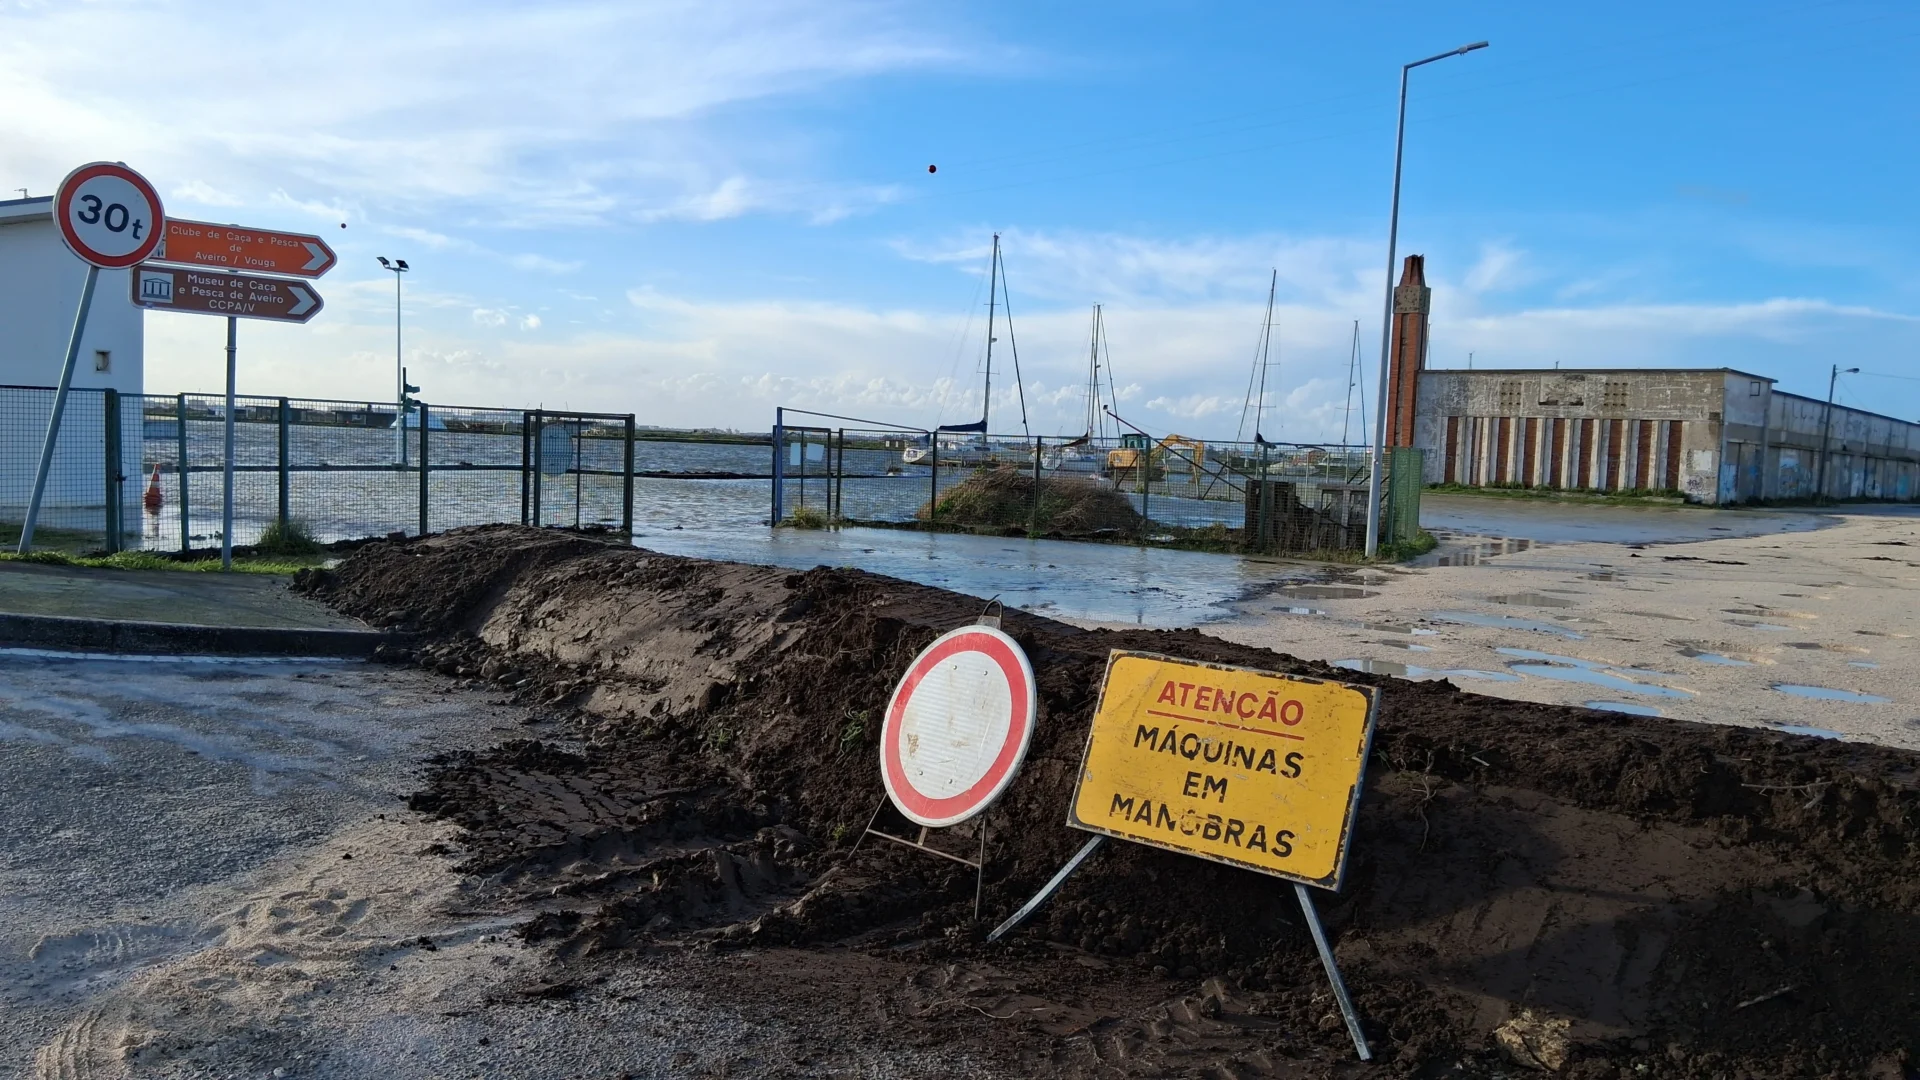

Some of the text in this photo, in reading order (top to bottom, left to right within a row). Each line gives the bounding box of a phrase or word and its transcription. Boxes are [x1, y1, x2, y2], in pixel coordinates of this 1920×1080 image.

[171, 225, 201, 237] Clube
[207, 230, 220, 239] de
[226, 231, 252, 244] Caça
[270, 236, 299, 248] Pesca
[229, 243, 242, 253] de
[195, 251, 227, 262] Aveiro
[244, 255, 276, 268] Vouga
[187, 274, 225, 286] Museu
[229, 278, 244, 288] de
[178, 286, 284, 304] e Pesca de Aveiro
[208, 299, 256, 313] CCPA/V
[1133, 723, 1305, 779] MÁQUINAS
[1182, 770, 1229, 804] EM
[1108, 792, 1296, 858] MANOBRAS
